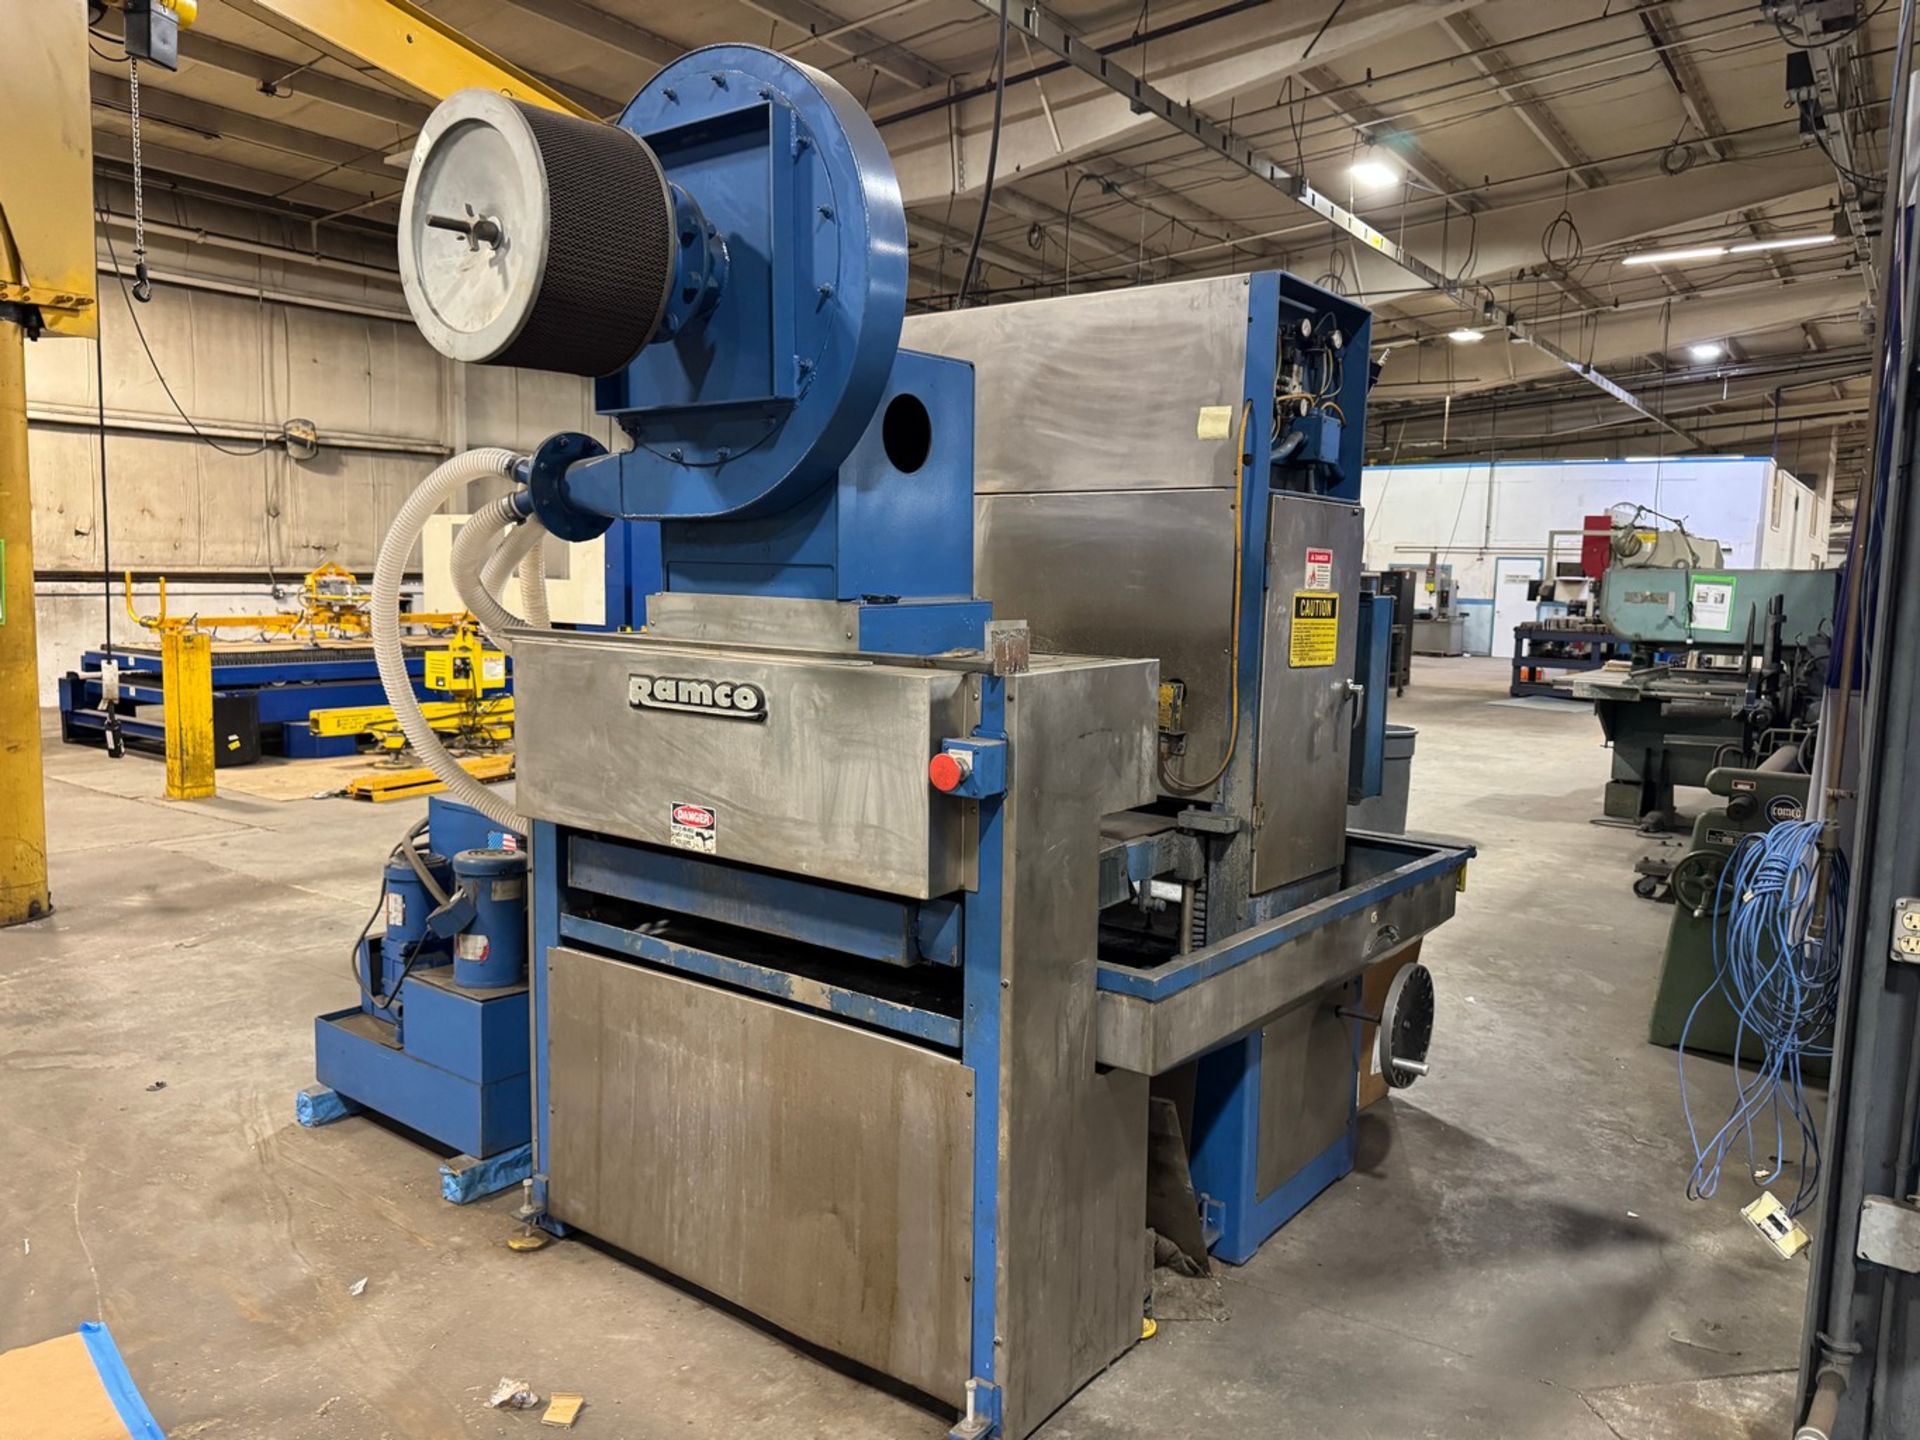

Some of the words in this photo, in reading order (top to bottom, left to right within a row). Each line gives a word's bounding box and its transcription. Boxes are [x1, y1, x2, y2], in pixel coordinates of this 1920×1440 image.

[1300, 599, 1332, 617] CAUTION
[629, 675, 761, 713] Ramco
[677, 809, 710, 826] DANGER
